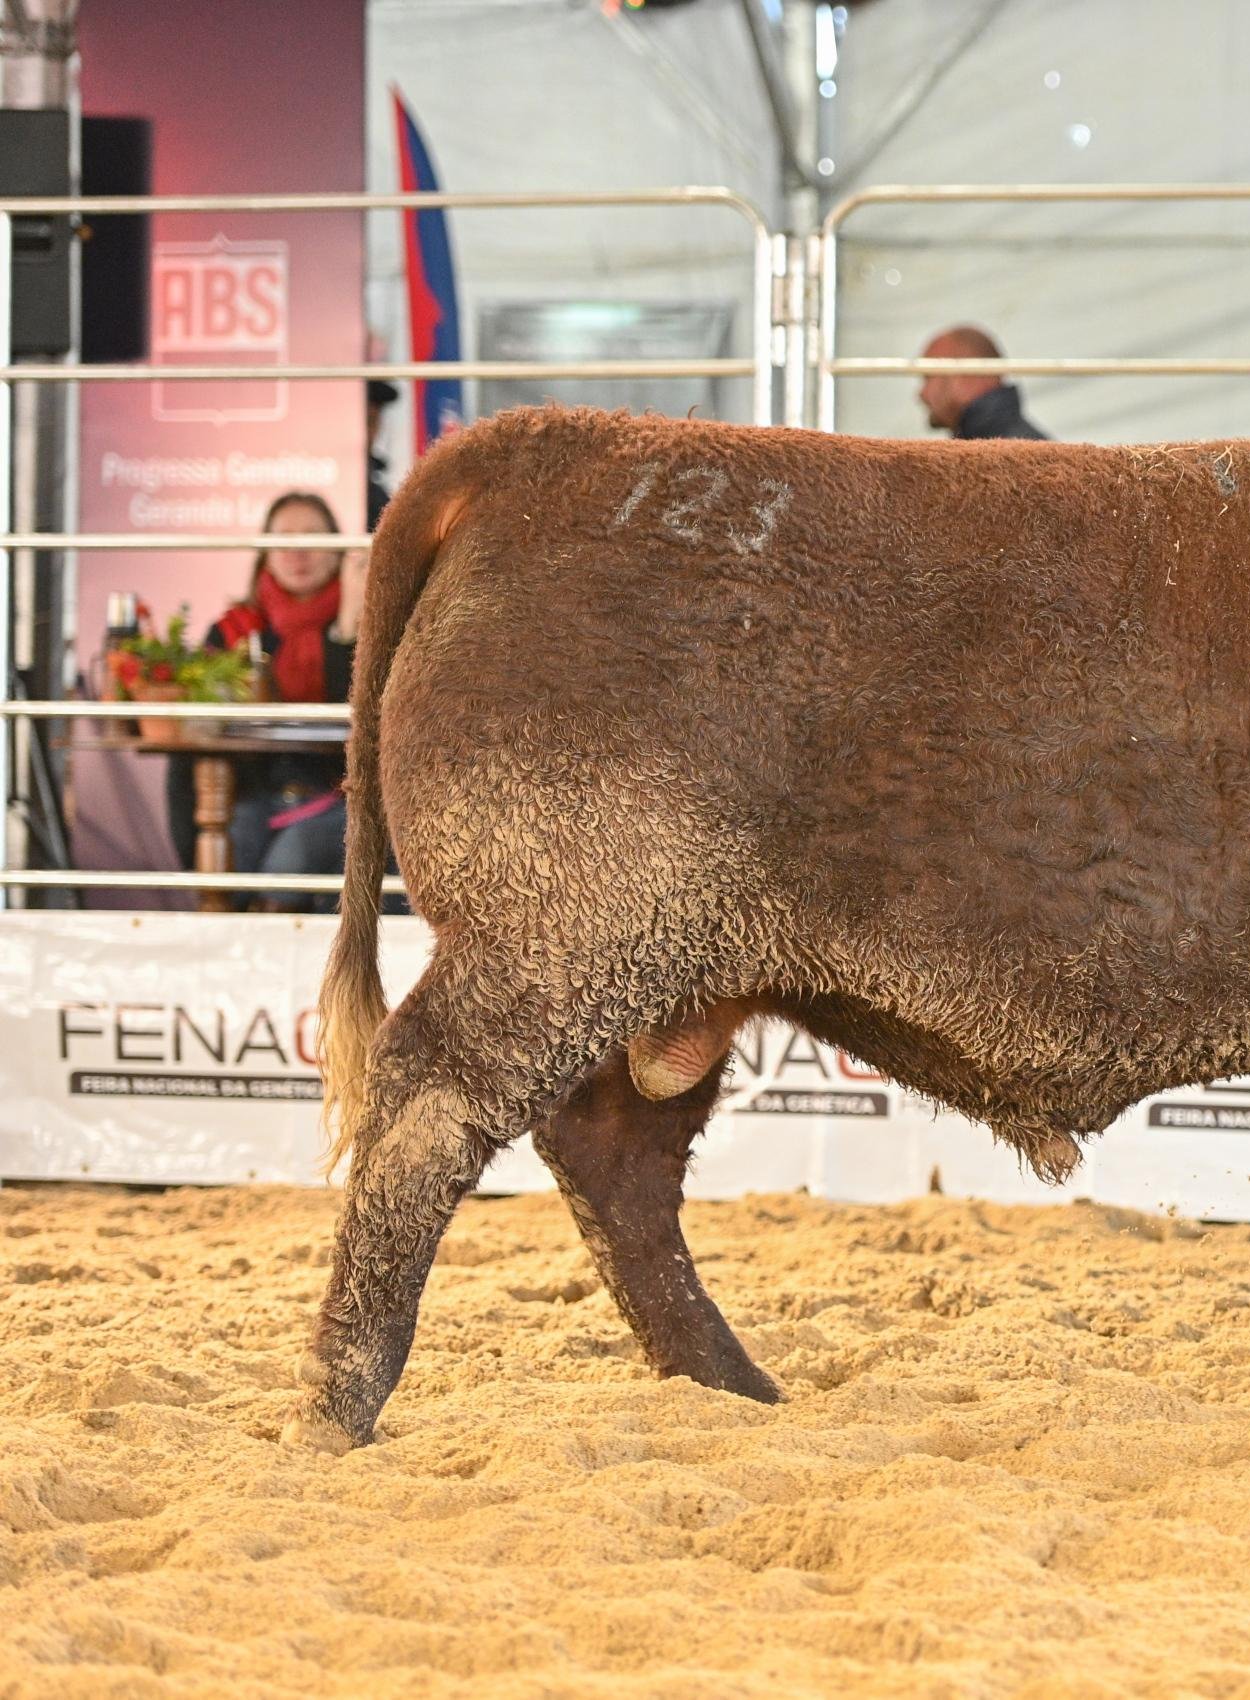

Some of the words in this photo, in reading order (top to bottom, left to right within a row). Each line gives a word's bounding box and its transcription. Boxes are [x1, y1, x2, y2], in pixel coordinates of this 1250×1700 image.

[161, 267, 279, 337] ABS
[614, 462, 795, 557] 123
[80, 1075, 130, 1093] FEIRA
[132, 1077, 219, 1096] NACIONAL
[220, 1080, 247, 1097] DA
[1160, 1108, 1217, 1127] FEIRA
